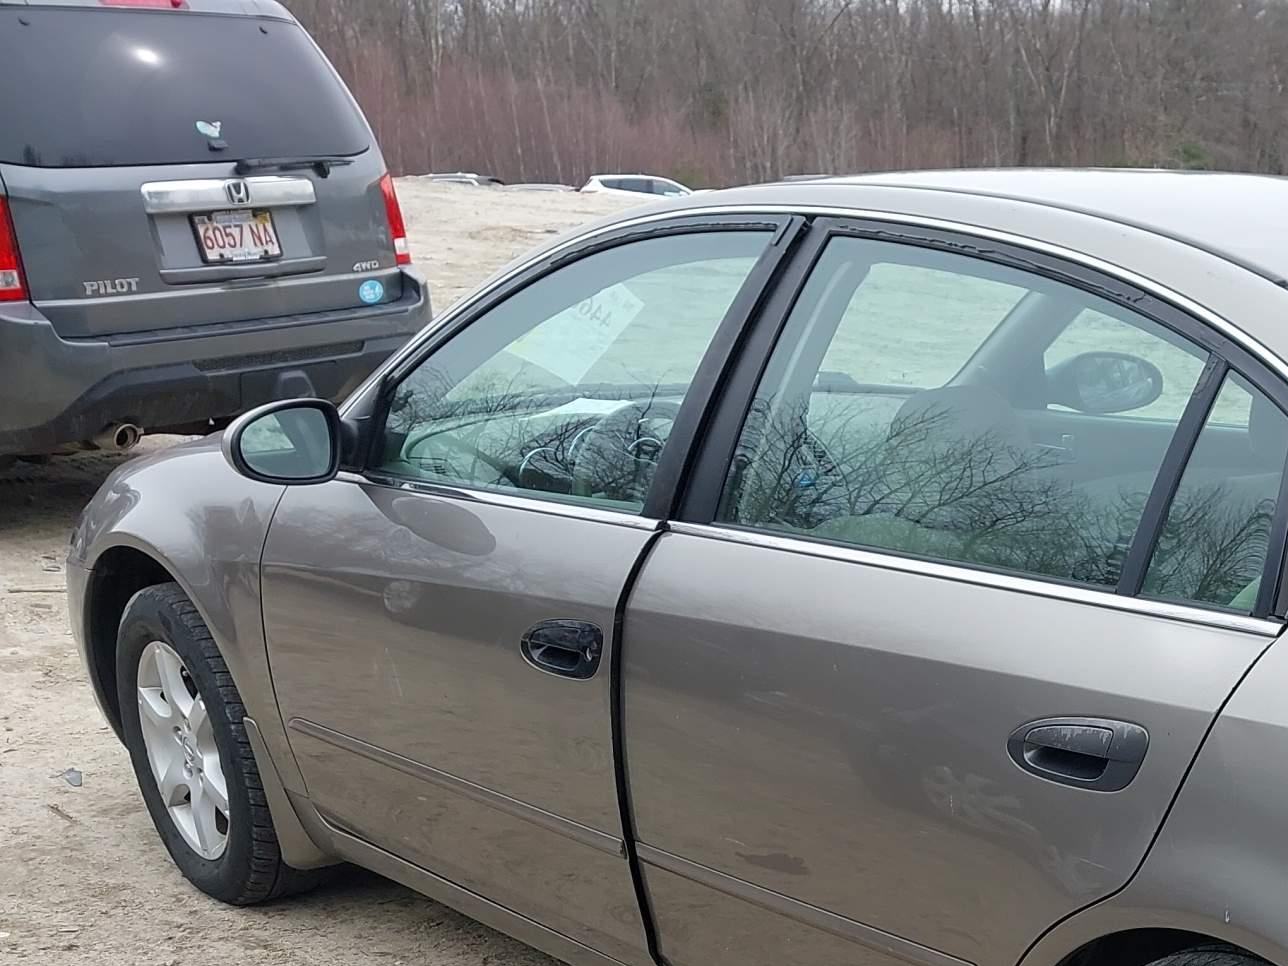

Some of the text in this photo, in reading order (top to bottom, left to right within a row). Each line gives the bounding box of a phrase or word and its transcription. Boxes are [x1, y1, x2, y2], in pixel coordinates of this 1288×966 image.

[202, 222, 275, 250] 6057 NA
[352, 260, 380, 273] 4WD
[82, 277, 140, 296] PILOT
